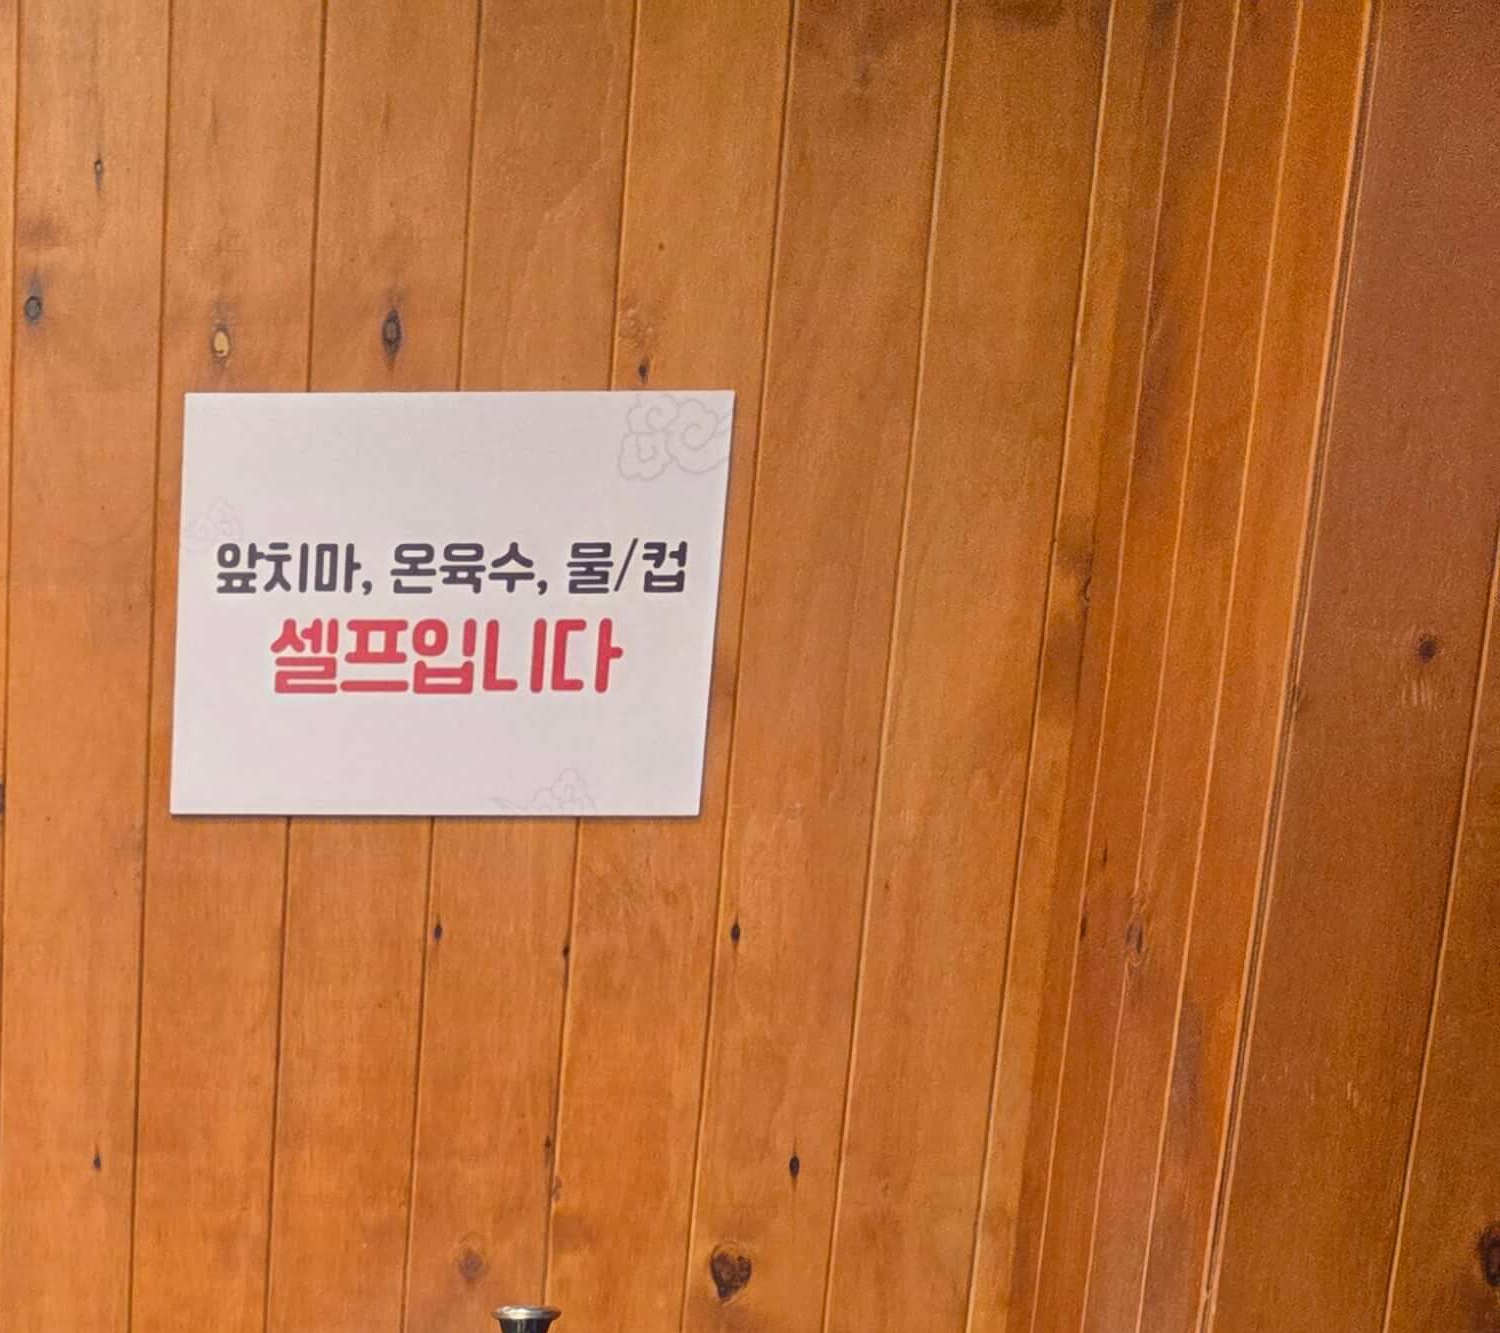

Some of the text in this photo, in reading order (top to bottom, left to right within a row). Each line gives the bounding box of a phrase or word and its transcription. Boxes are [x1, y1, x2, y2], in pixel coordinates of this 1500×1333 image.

[216, 537, 689, 595] 앞치마, 온육수, 물/컵
[270, 617, 623, 694] 셀프입니다
